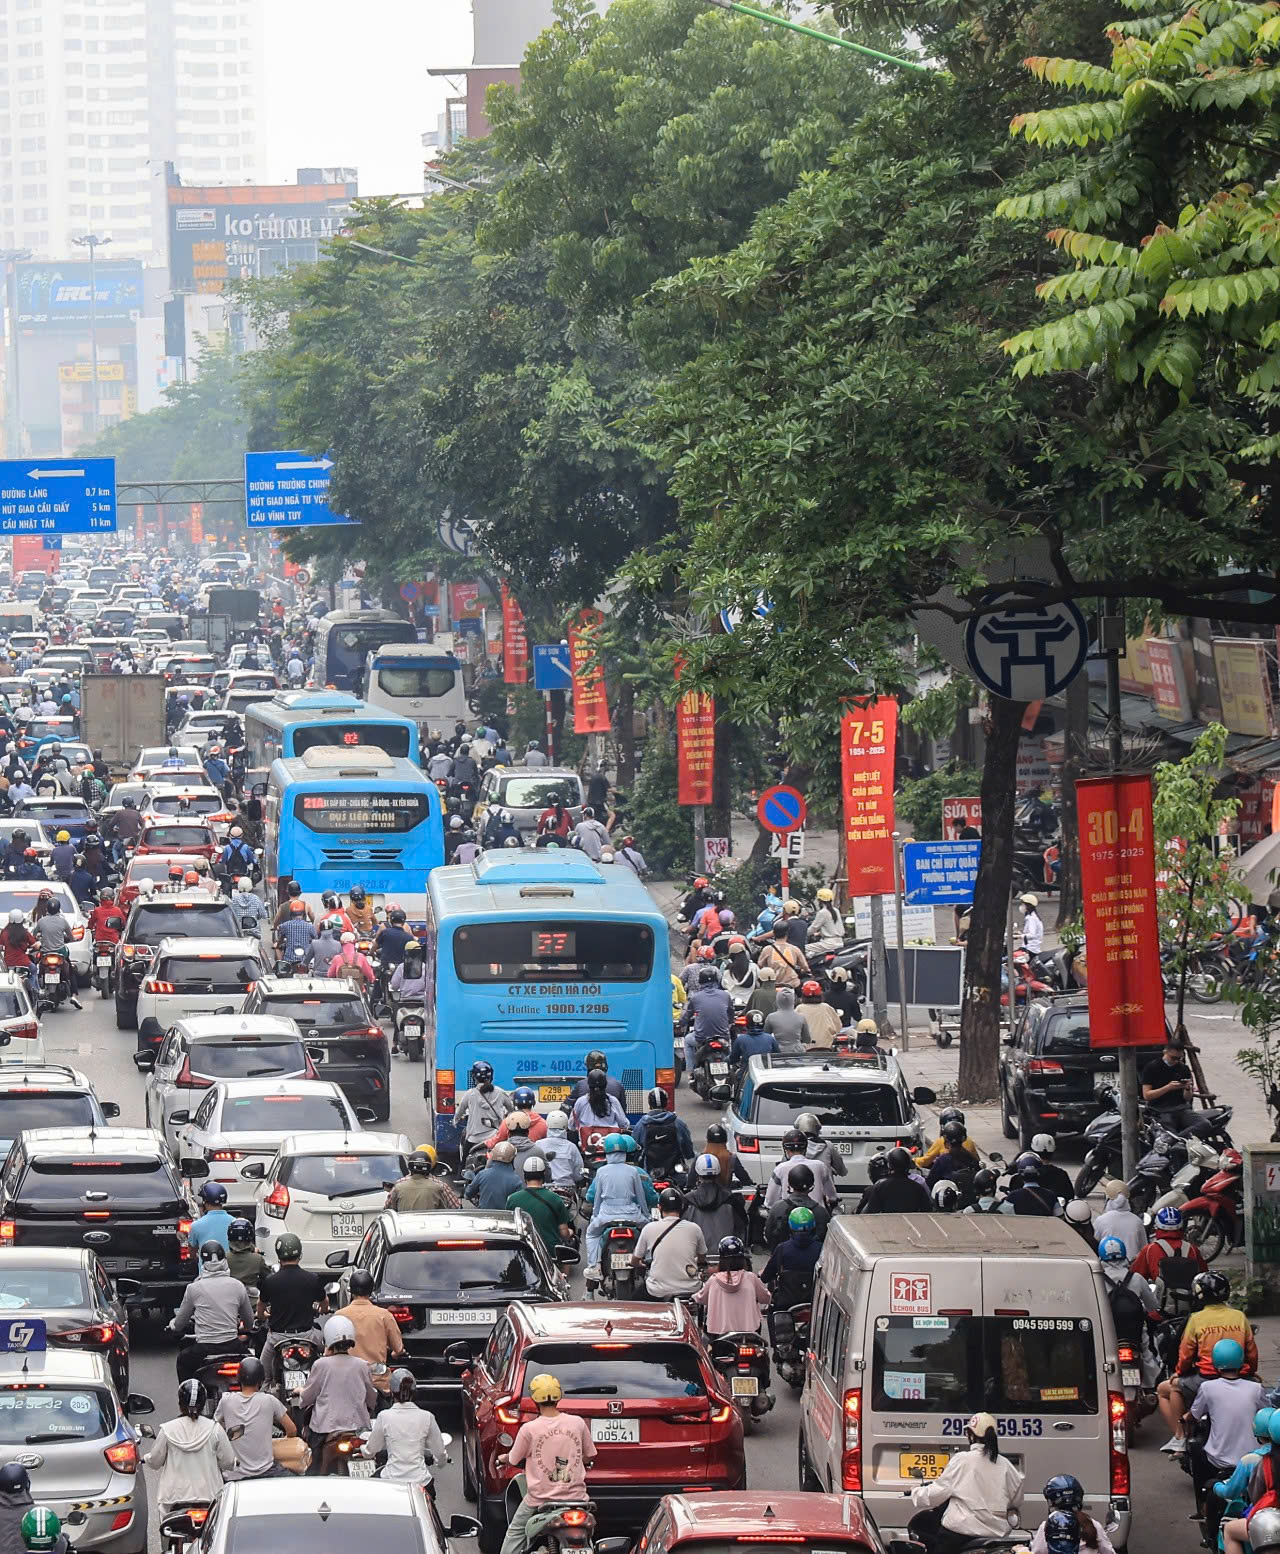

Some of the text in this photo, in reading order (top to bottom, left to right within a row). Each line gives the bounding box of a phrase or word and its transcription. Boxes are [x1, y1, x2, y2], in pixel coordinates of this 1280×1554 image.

[249, 479, 275, 491] ĐƯỜNG
[277, 478, 306, 490] TRƯỜNG
[1, 487, 26, 499] ĐƯỜNG
[28, 487, 48, 498] LÁNG
[98, 488, 110, 496] km
[250, 495, 264, 507] NÚT
[266, 497, 283, 506] GIAO
[2, 501, 111, 514] NÚT GIAO CẦU GIẤY 5 km
[251, 510, 302, 522] CẦU VĨNH TUY
[2, 518, 111, 530] CẦU NHẬT TÂN 11 km
[849, 720, 884, 745] 7-5
[943, 801, 968, 818] SỬA
[1087, 807, 1144, 846] 30-4
[508, 983, 601, 998] CT XE ĐIỆN HÀ NỘI
[507, 1004, 609, 1014] Hotline 1900.1296
[516, 1060, 539, 1072] 29B
[340, 1215, 356, 1225] 30A
[893, 1305, 916, 1313] SCHOOL
[436, 1313, 492, 1322] 30H-908.33
[1013, 1319, 1074, 1331] 0945 599 599
[1200, 1324, 1241, 1336] VIETNAM
[8, 1322, 35, 1348] G7
[45, 1400, 62, 1409] 32
[605, 1420, 626, 1430] 30L
[882, 1420, 928, 1429] TRANSIT
[997, 1418, 1043, 1436] 59.53
[597, 1431, 633, 1441] 005.41
[914, 1455, 936, 1465] 29B
